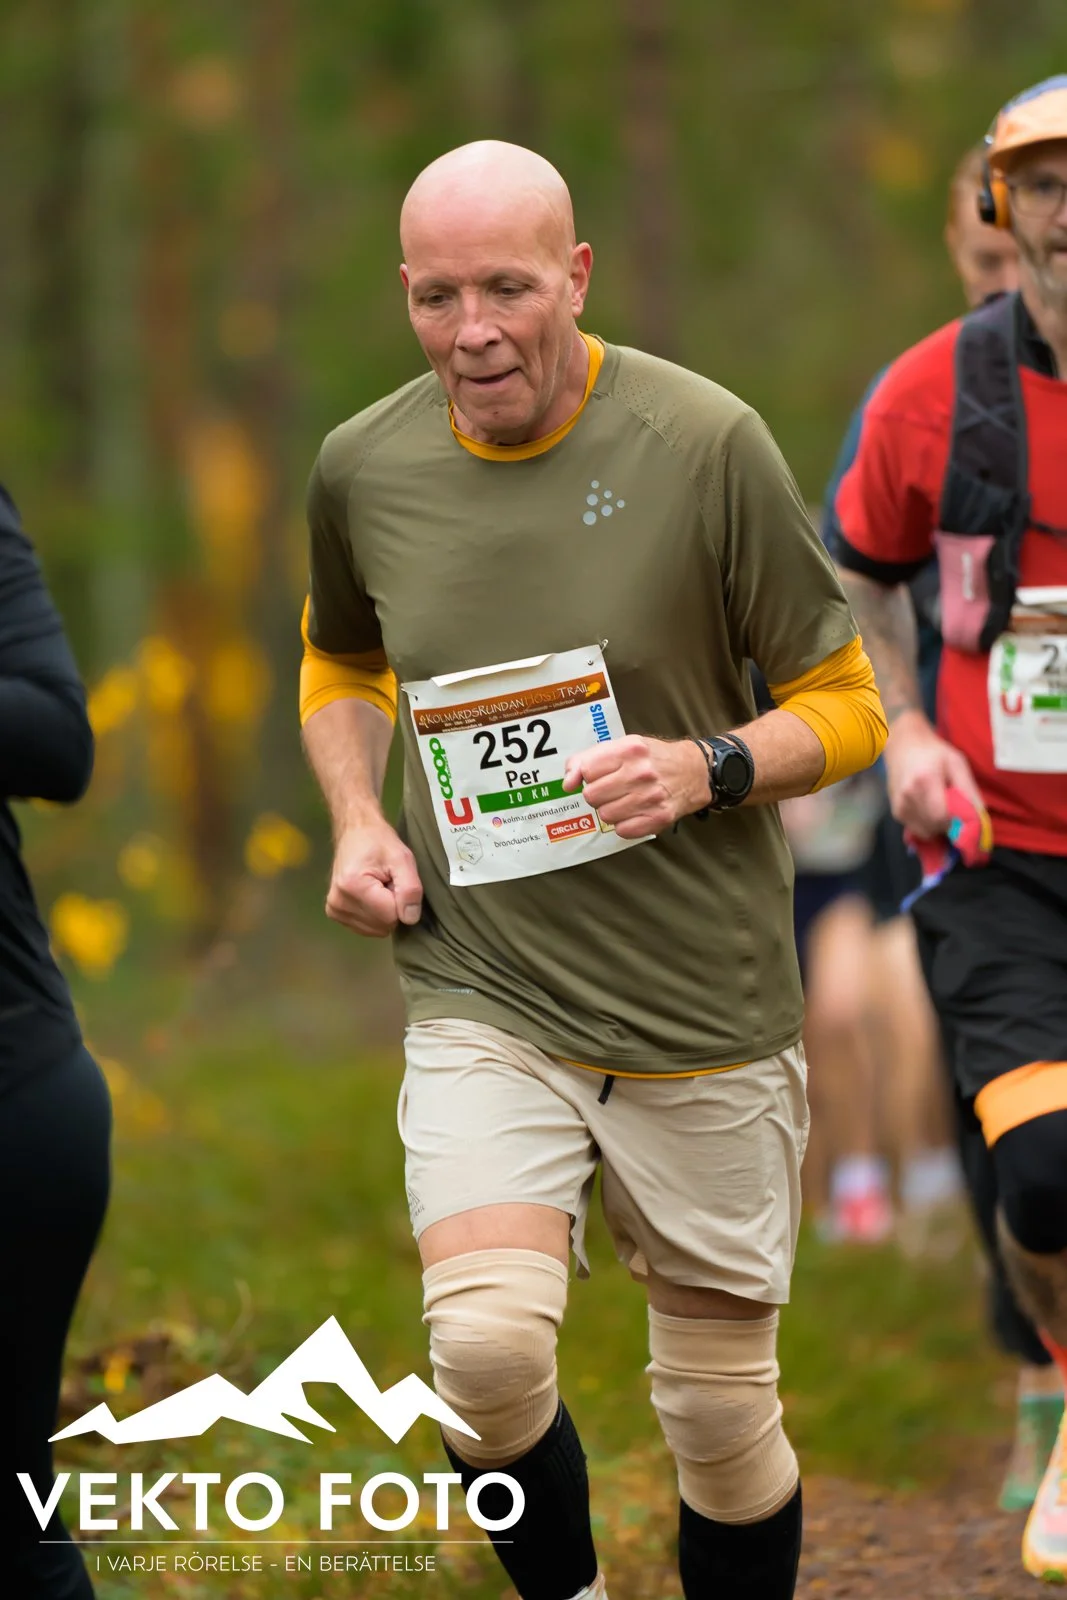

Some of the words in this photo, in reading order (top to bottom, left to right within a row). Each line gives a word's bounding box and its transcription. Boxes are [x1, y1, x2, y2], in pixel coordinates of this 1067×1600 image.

[590, 703, 611, 744] ivitus
[473, 719, 558, 770] 252
[429, 737, 453, 800] coop
[505, 769, 540, 789] Per
[508, 792, 523, 805] 10
[531, 786, 550, 800] KM
[449, 825, 477, 834] UMARA
[551, 822, 579, 836] CIRCLE
[579, 817, 591, 829] K
